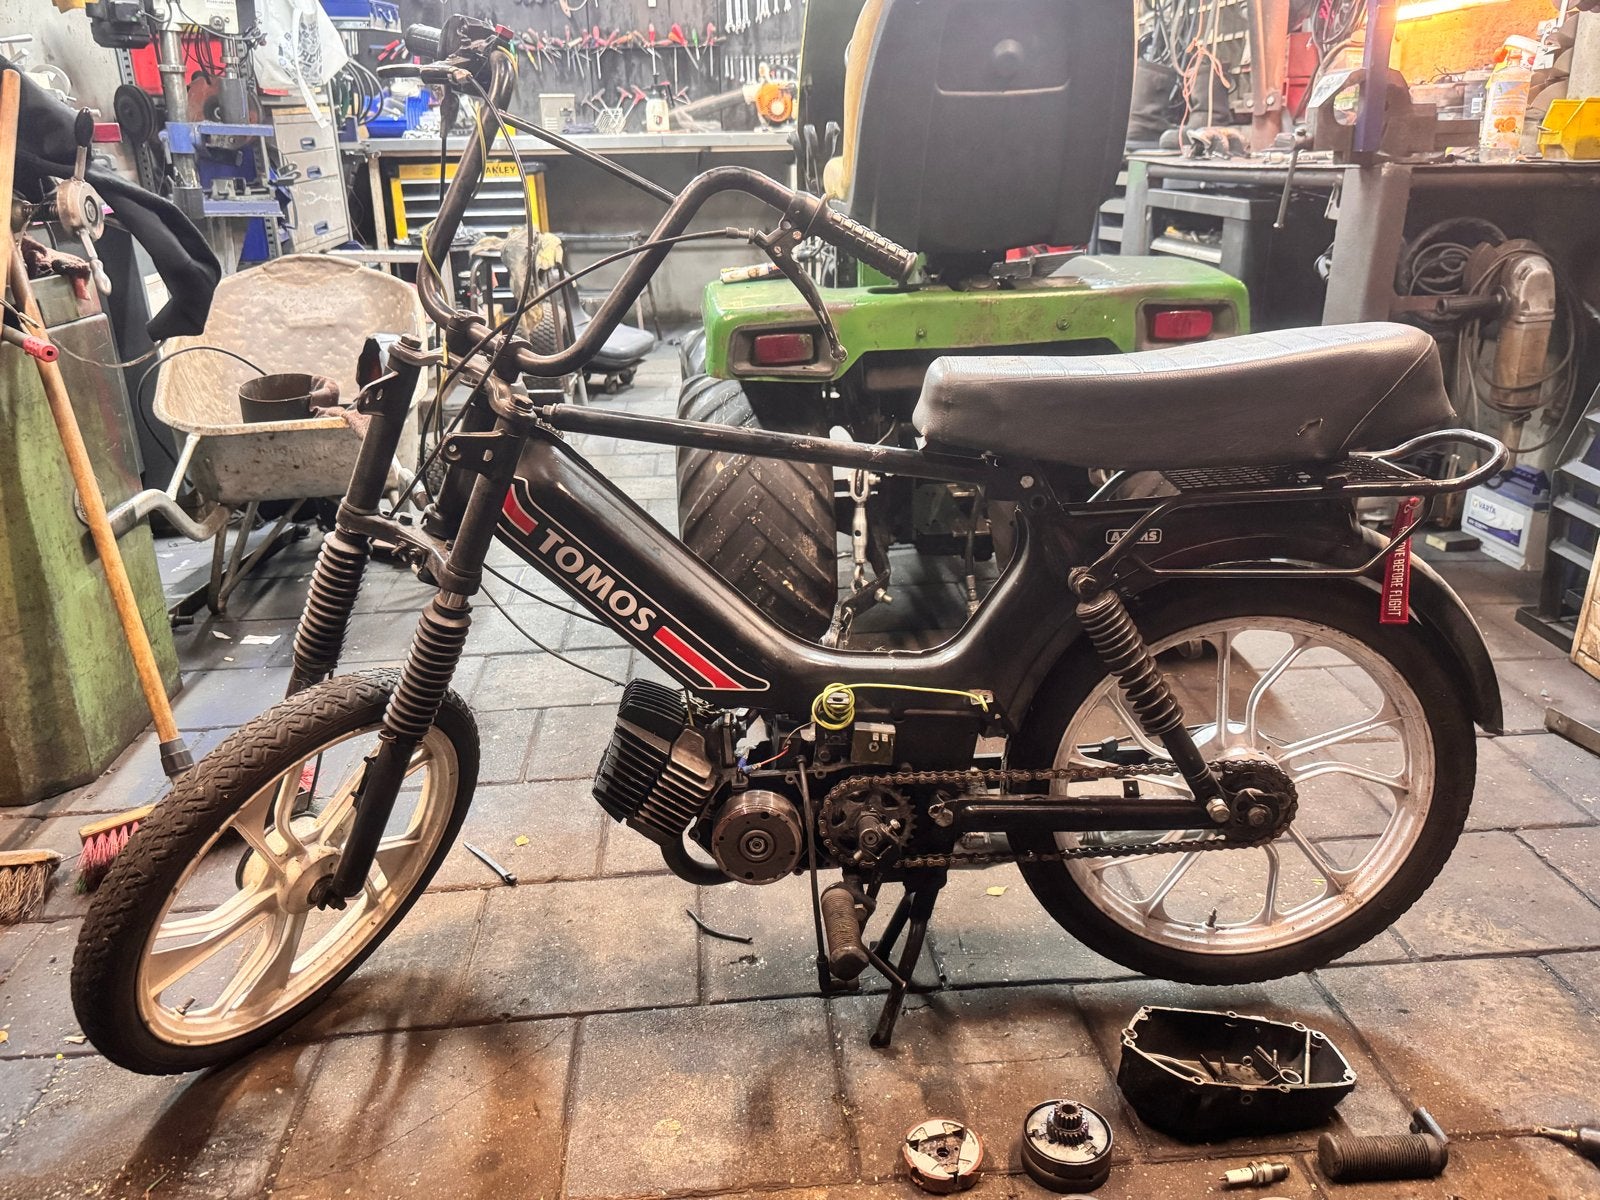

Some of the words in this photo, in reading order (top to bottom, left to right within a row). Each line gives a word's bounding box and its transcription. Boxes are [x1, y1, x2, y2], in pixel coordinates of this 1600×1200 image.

[538, 528, 657, 631] TOMOS
[1390, 560, 1405, 588] BEFORE
[1387, 589, 1403, 617] FLIGHT
